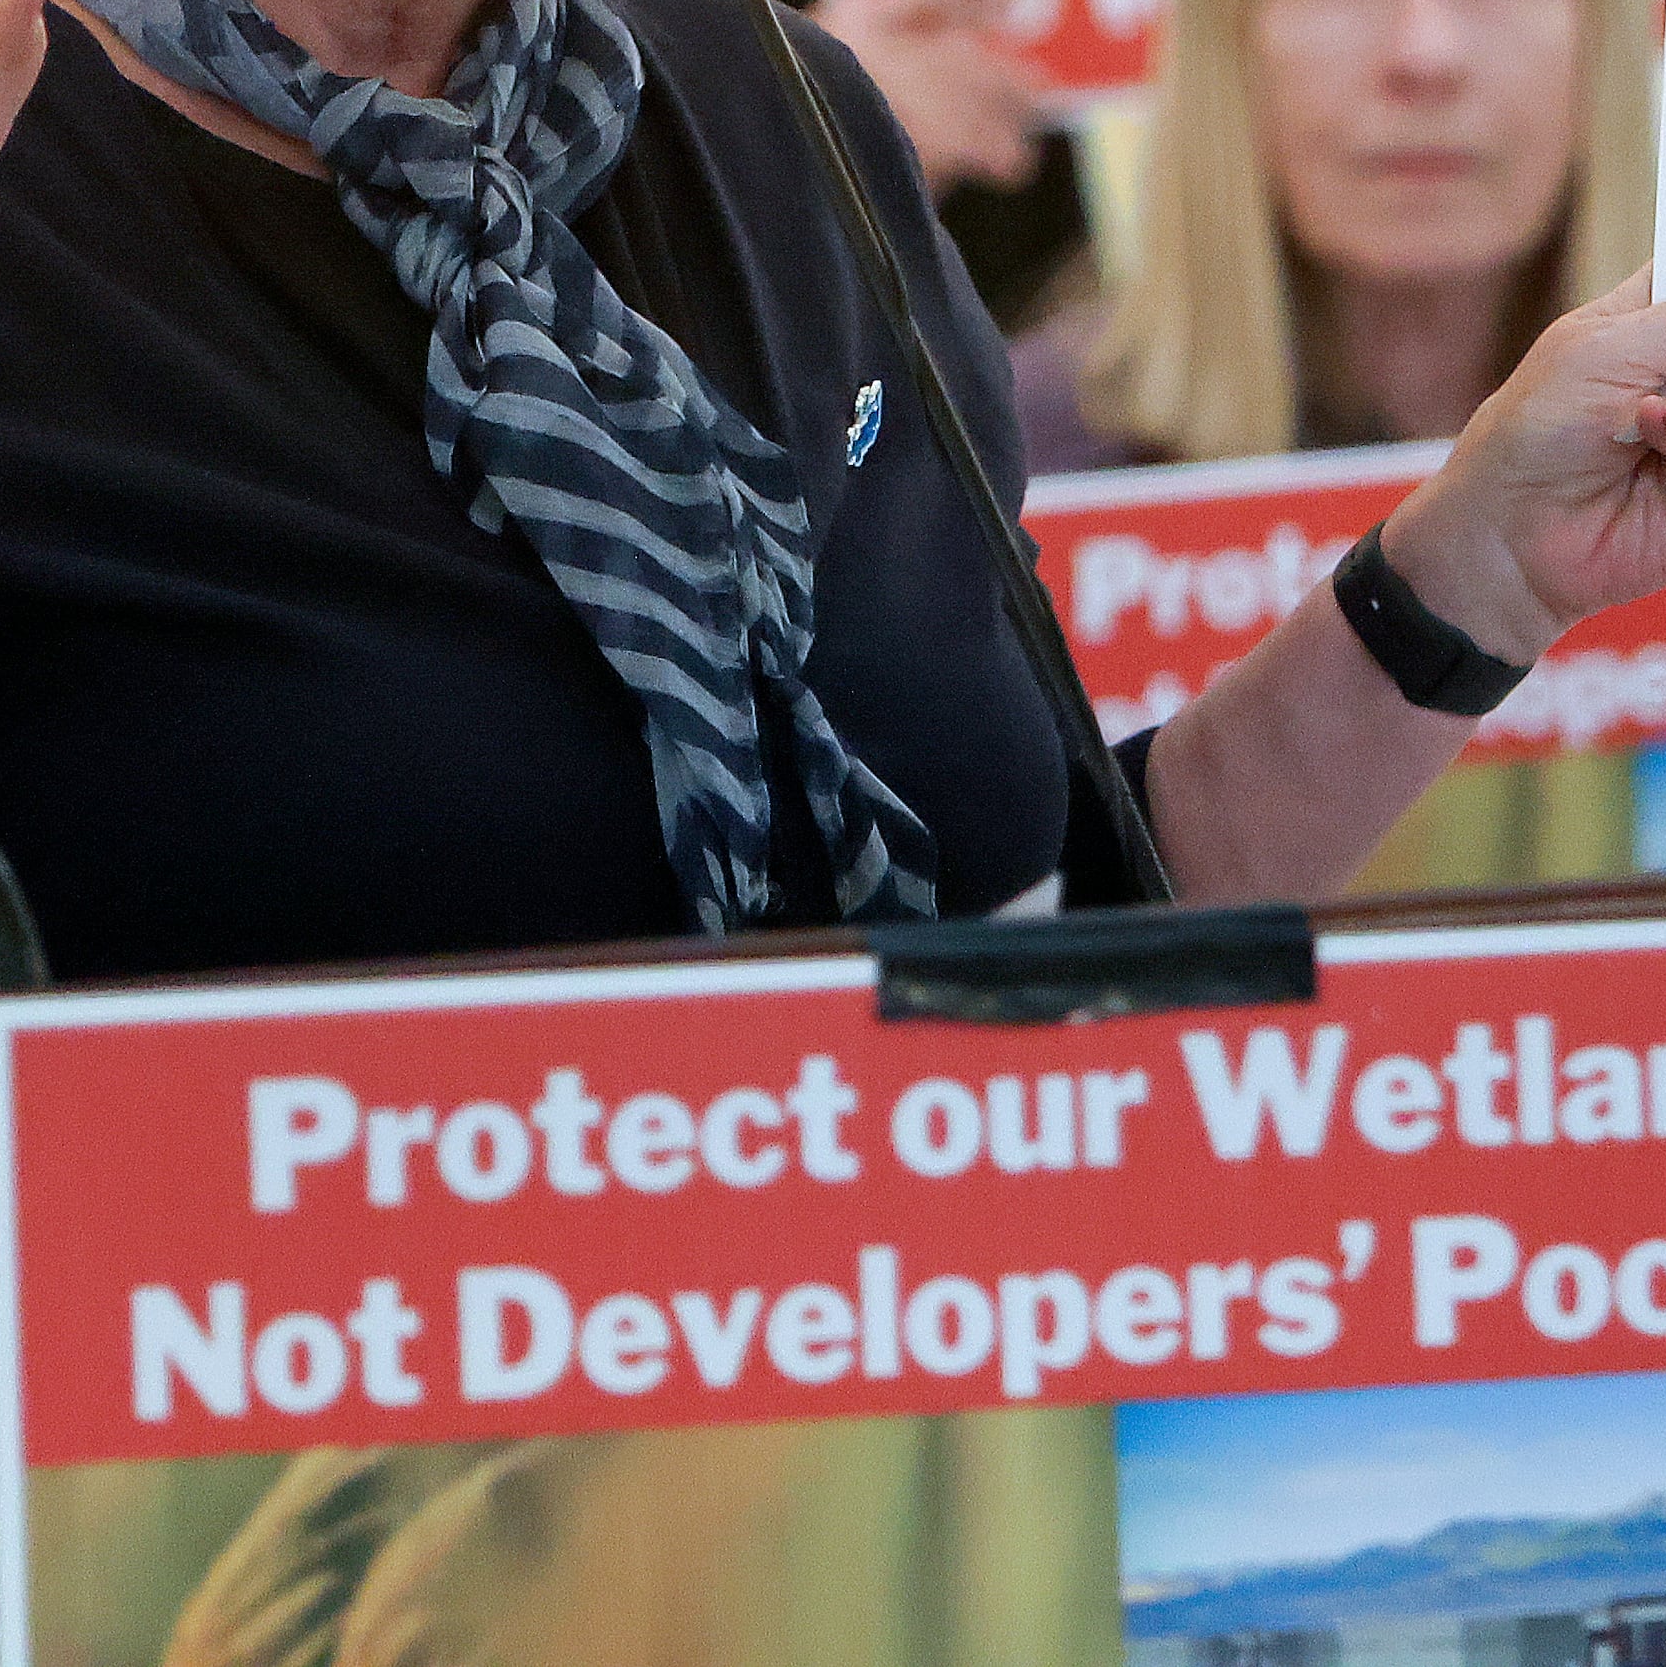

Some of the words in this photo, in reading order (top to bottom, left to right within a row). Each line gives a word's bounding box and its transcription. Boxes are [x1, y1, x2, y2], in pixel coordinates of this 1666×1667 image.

[246, 1052, 861, 1216] Protect
[888, 1066, 1151, 1182] our
[131, 1274, 428, 1424] Not
